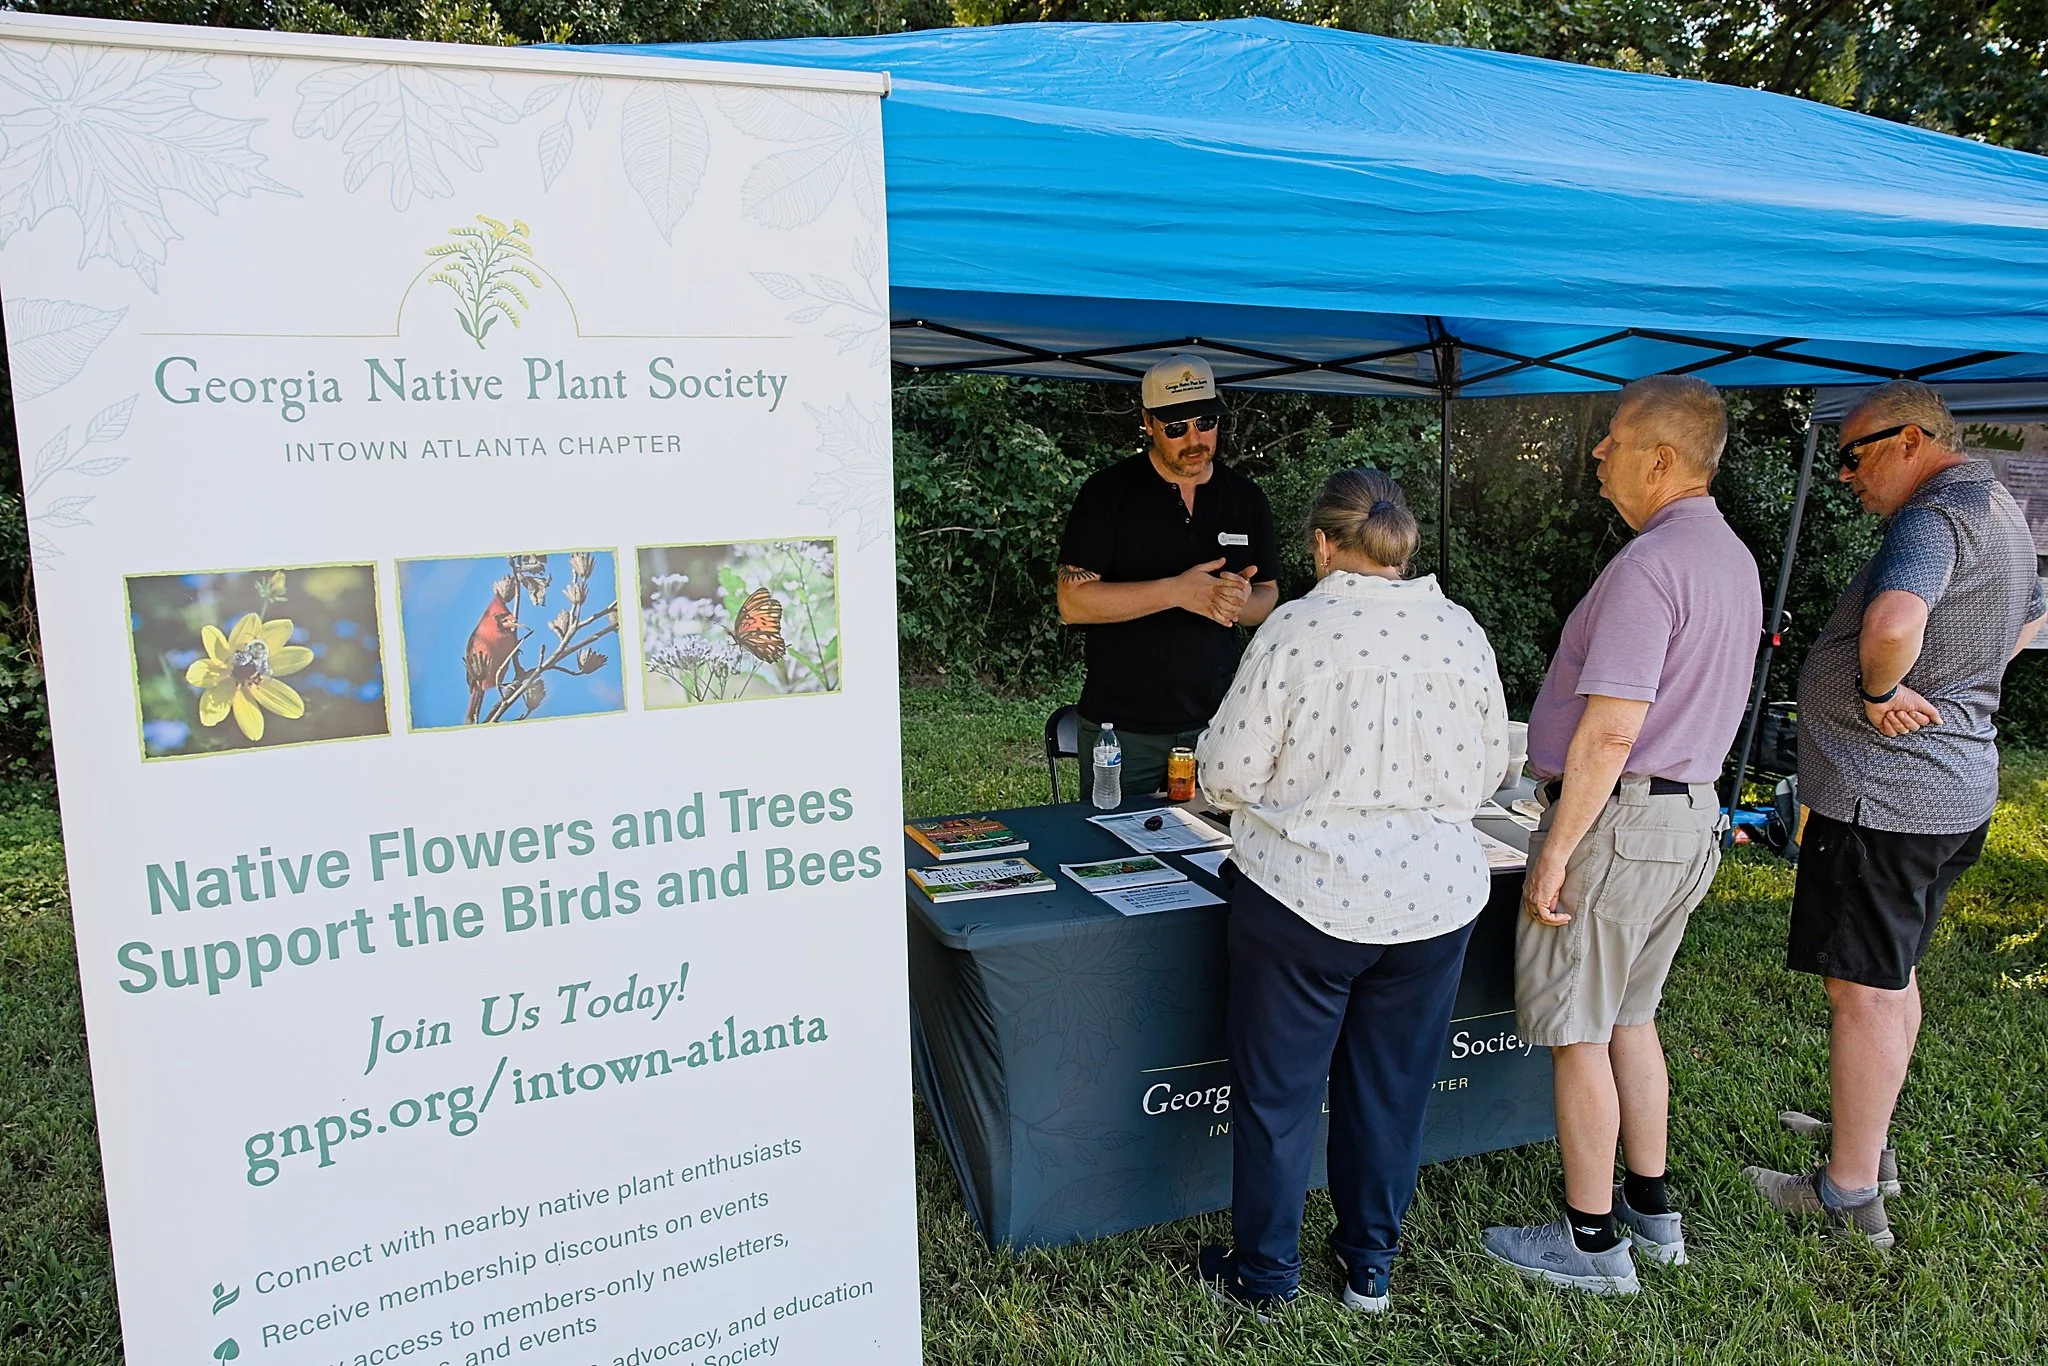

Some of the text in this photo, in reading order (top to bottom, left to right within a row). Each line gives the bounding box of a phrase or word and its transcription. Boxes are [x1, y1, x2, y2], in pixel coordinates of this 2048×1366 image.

[155, 356, 788, 423] Georgia Native Plant Society
[286, 435, 681, 463] INTOWN ATLANTA CHAPTER
[146, 787, 854, 916] Native Flowers and Trees
[118, 845, 882, 996] Support the Birds and Bees
[364, 961, 690, 1076] Join Us Today!
[244, 1014, 829, 1187] gnps.org/intown-atlanta
[1142, 1083, 1231, 1115] Georg
[255, 1138, 802, 1294] Connect with nearby native plant enthusiasts
[262, 1191, 769, 1348] Receive membership discounts on events
[353, 1232, 789, 1366] access to members-only newsletters,
[465, 1317, 597, 1366] and events
[612, 1281, 873, 1366] advocacy, and education
[703, 1335, 780, 1366] Society
